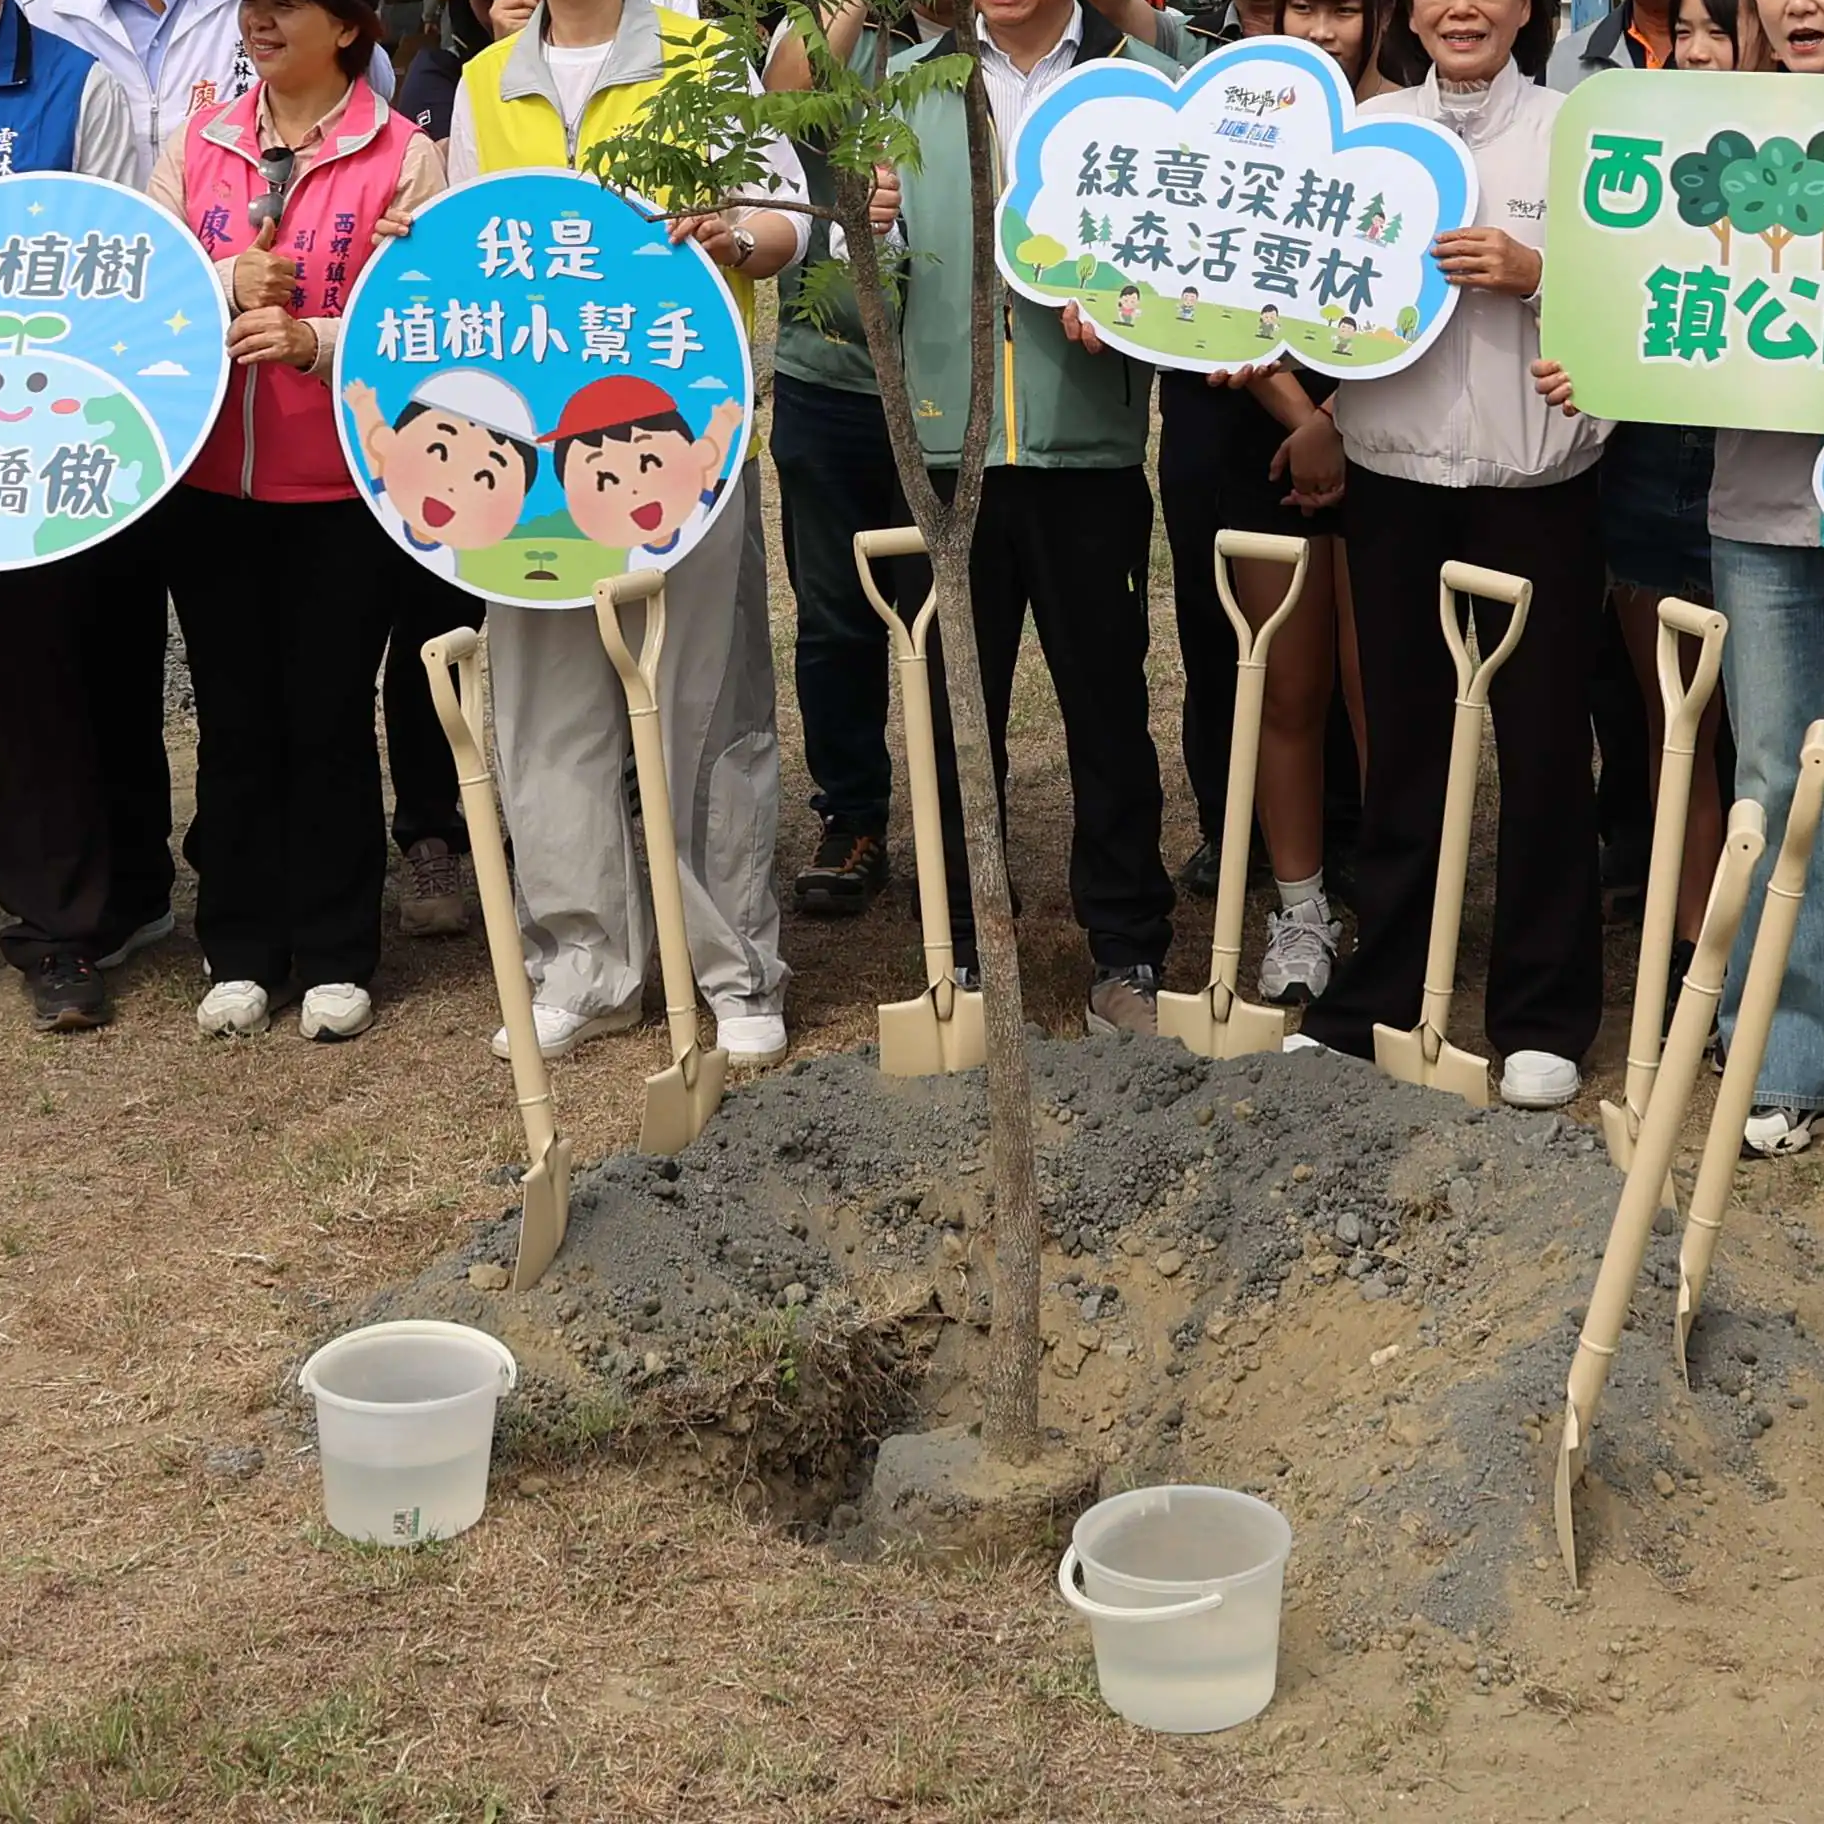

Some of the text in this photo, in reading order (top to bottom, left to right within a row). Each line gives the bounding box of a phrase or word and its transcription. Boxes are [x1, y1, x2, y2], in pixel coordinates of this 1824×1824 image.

[1076, 140, 1356, 238] 綠意深耕
[322, 213, 356, 318] 西螺鎮民
[477, 216, 604, 280] 我是
[1111, 210, 1383, 315] 森活雲林
[377, 298, 705, 370] 植樹小幫手
